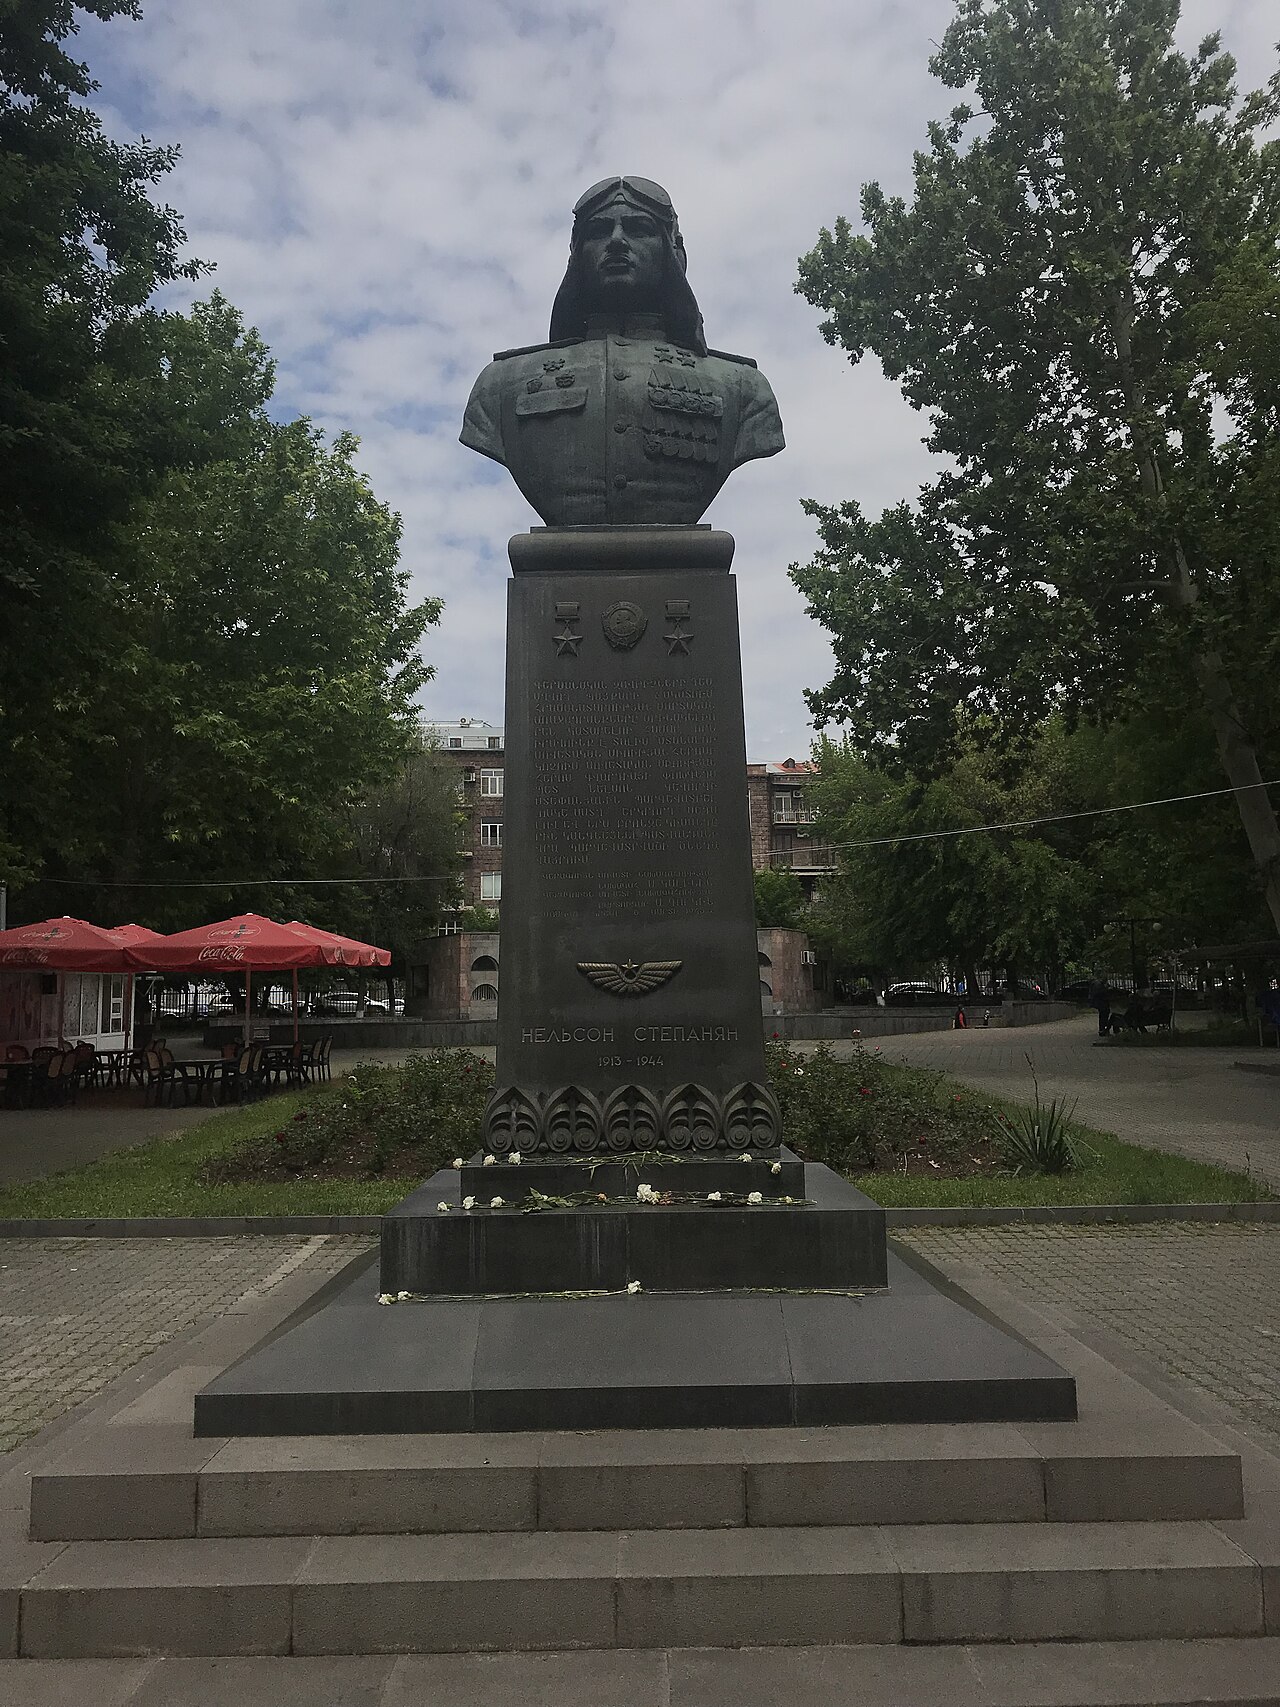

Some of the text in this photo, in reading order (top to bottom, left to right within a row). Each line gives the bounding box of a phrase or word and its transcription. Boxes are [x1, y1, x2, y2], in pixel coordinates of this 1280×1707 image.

[521, 1026, 739, 1043] НЕЛЬСОН СТЕПАНЯН
[598, 1055, 623, 1067] 1913
[636, 1055, 665, 1067] 1944
